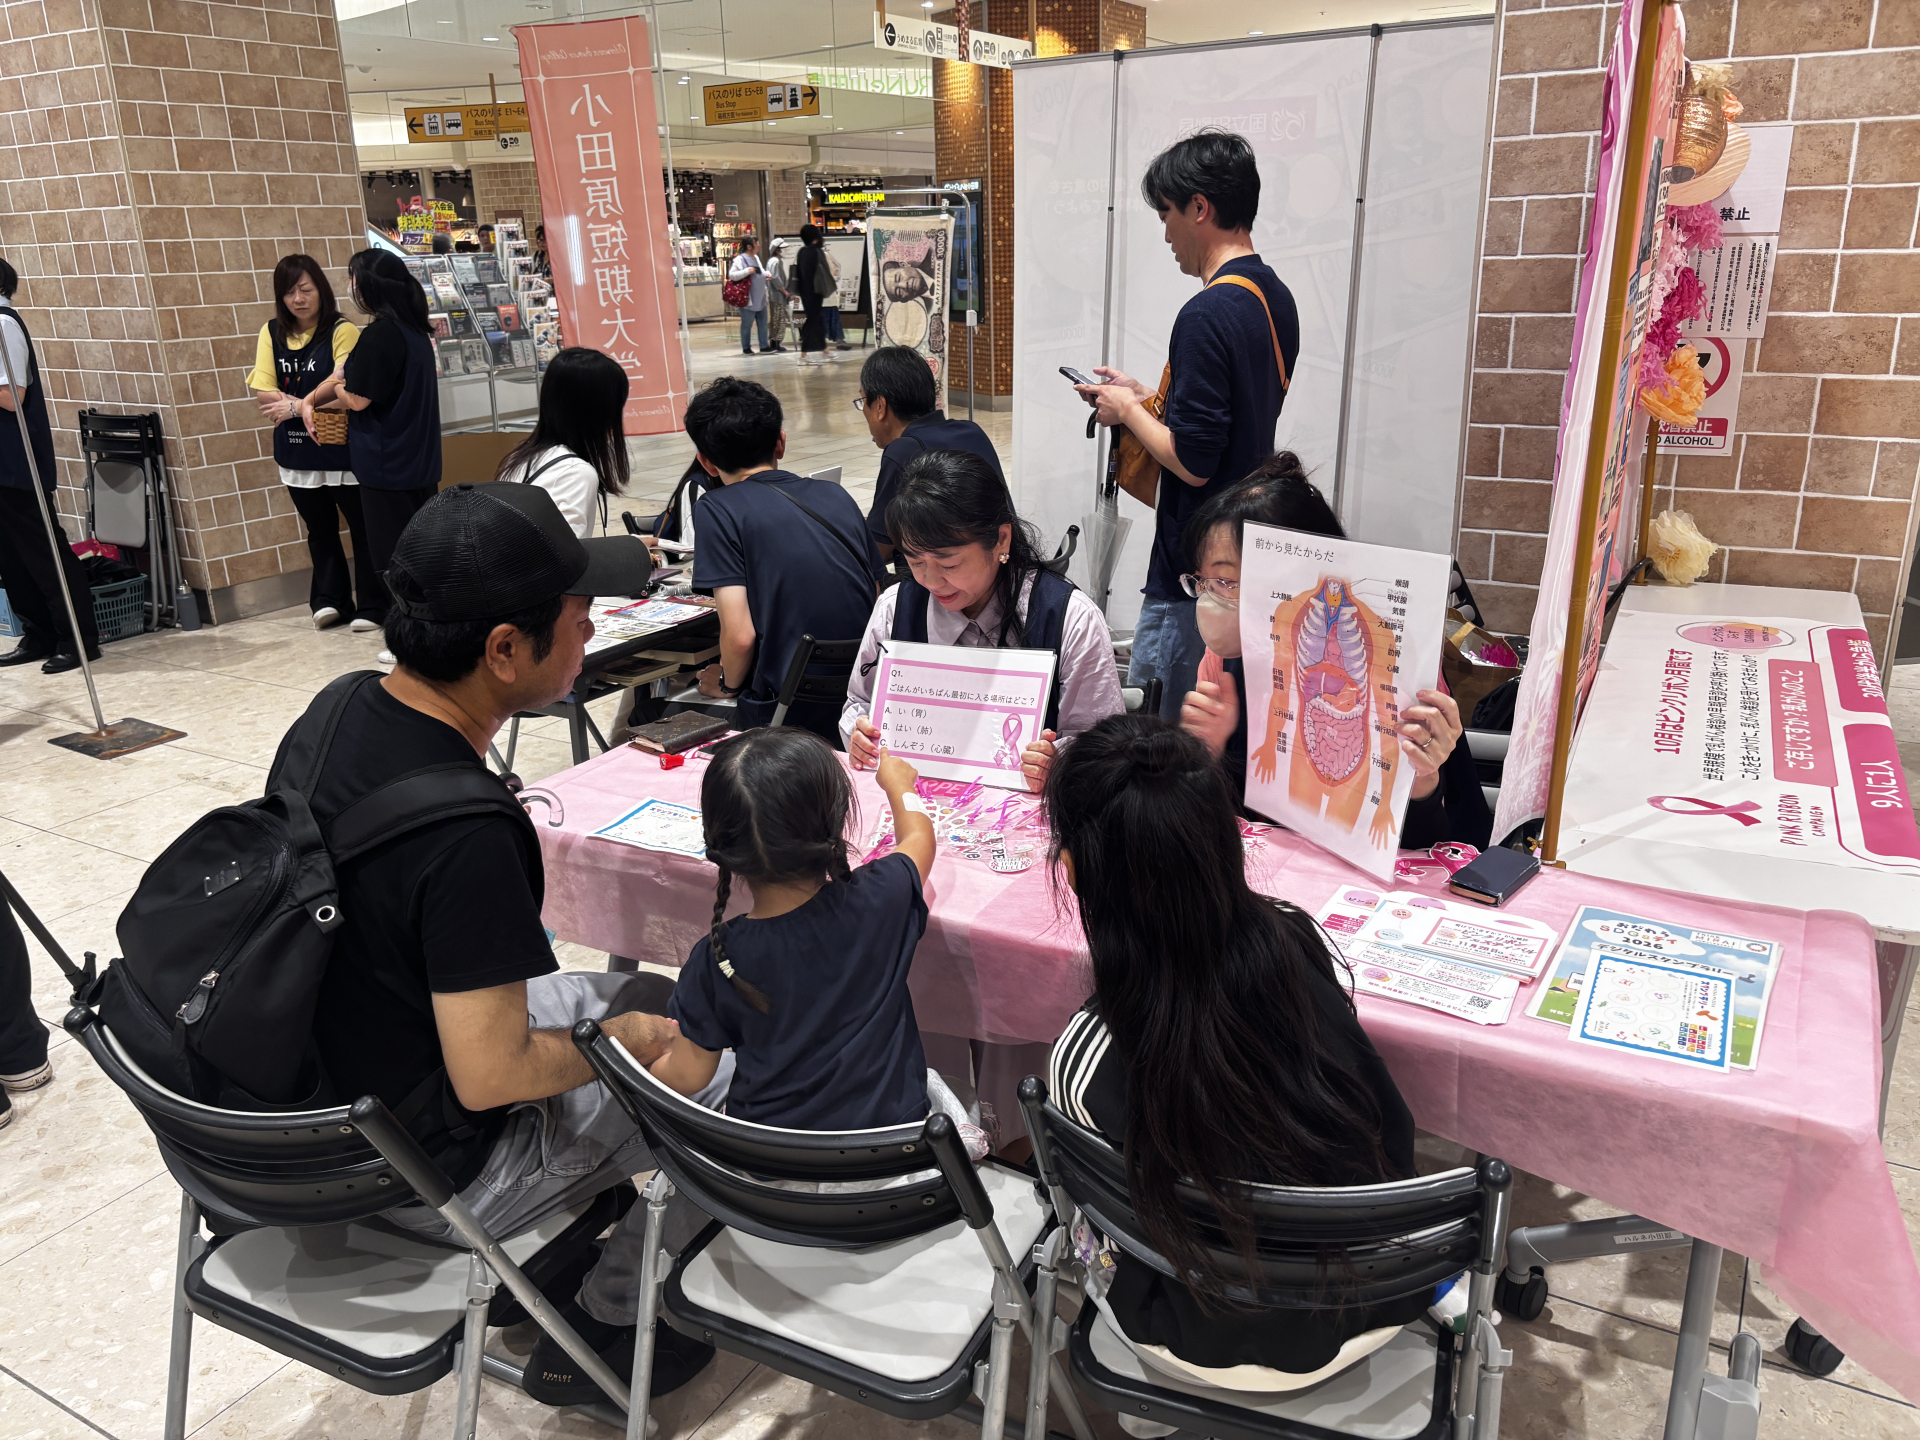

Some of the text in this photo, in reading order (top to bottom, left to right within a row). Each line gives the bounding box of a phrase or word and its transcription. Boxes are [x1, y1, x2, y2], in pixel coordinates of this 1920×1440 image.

[897, 33, 923, 47] うめまる広場
[709, 87, 743, 100] バスのりば
[725, 100, 736, 110] Stop
[829, 193, 849, 203] KALDI
[1719, 206, 1751, 221] 禁止
[279, 358, 317, 373] hik
[1663, 436, 1715, 446] ALCOHOL
[1255, 537, 1334, 563] 前から見たからだ
[890, 669, 903, 678] Q1.
[889, 683, 1035, 706] ごはんがいちばん最初に入る場所はどこ？
[1653, 648, 1693, 755] 10月はピンクリボン月間です
[884, 707, 927, 719] A. い（胃）
[1778, 669, 1815, 770] ご存じですか？乳がんのこと
[882, 722, 933, 735] B. はい（肺）
[879, 738, 956, 755] C. しんぞう（心臓）
[1860, 759, 1903, 809] 9人に1人
[1777, 793, 1808, 847] PINK RIBBON
[1809, 804, 1826, 837] CAMPAIGN
[1600, 924, 1678, 945] SDGsデイ
[1616, 922, 1670, 938] おだわら
[1622, 936, 1664, 950] 2026
[1695, 934, 1736, 946] MIRAI
[1596, 942, 1735, 976] デジタルスタンプラリー
[1624, 1231, 1673, 1242] ハルネ小田原
[543, 1371, 572, 1380] DUNLOP
